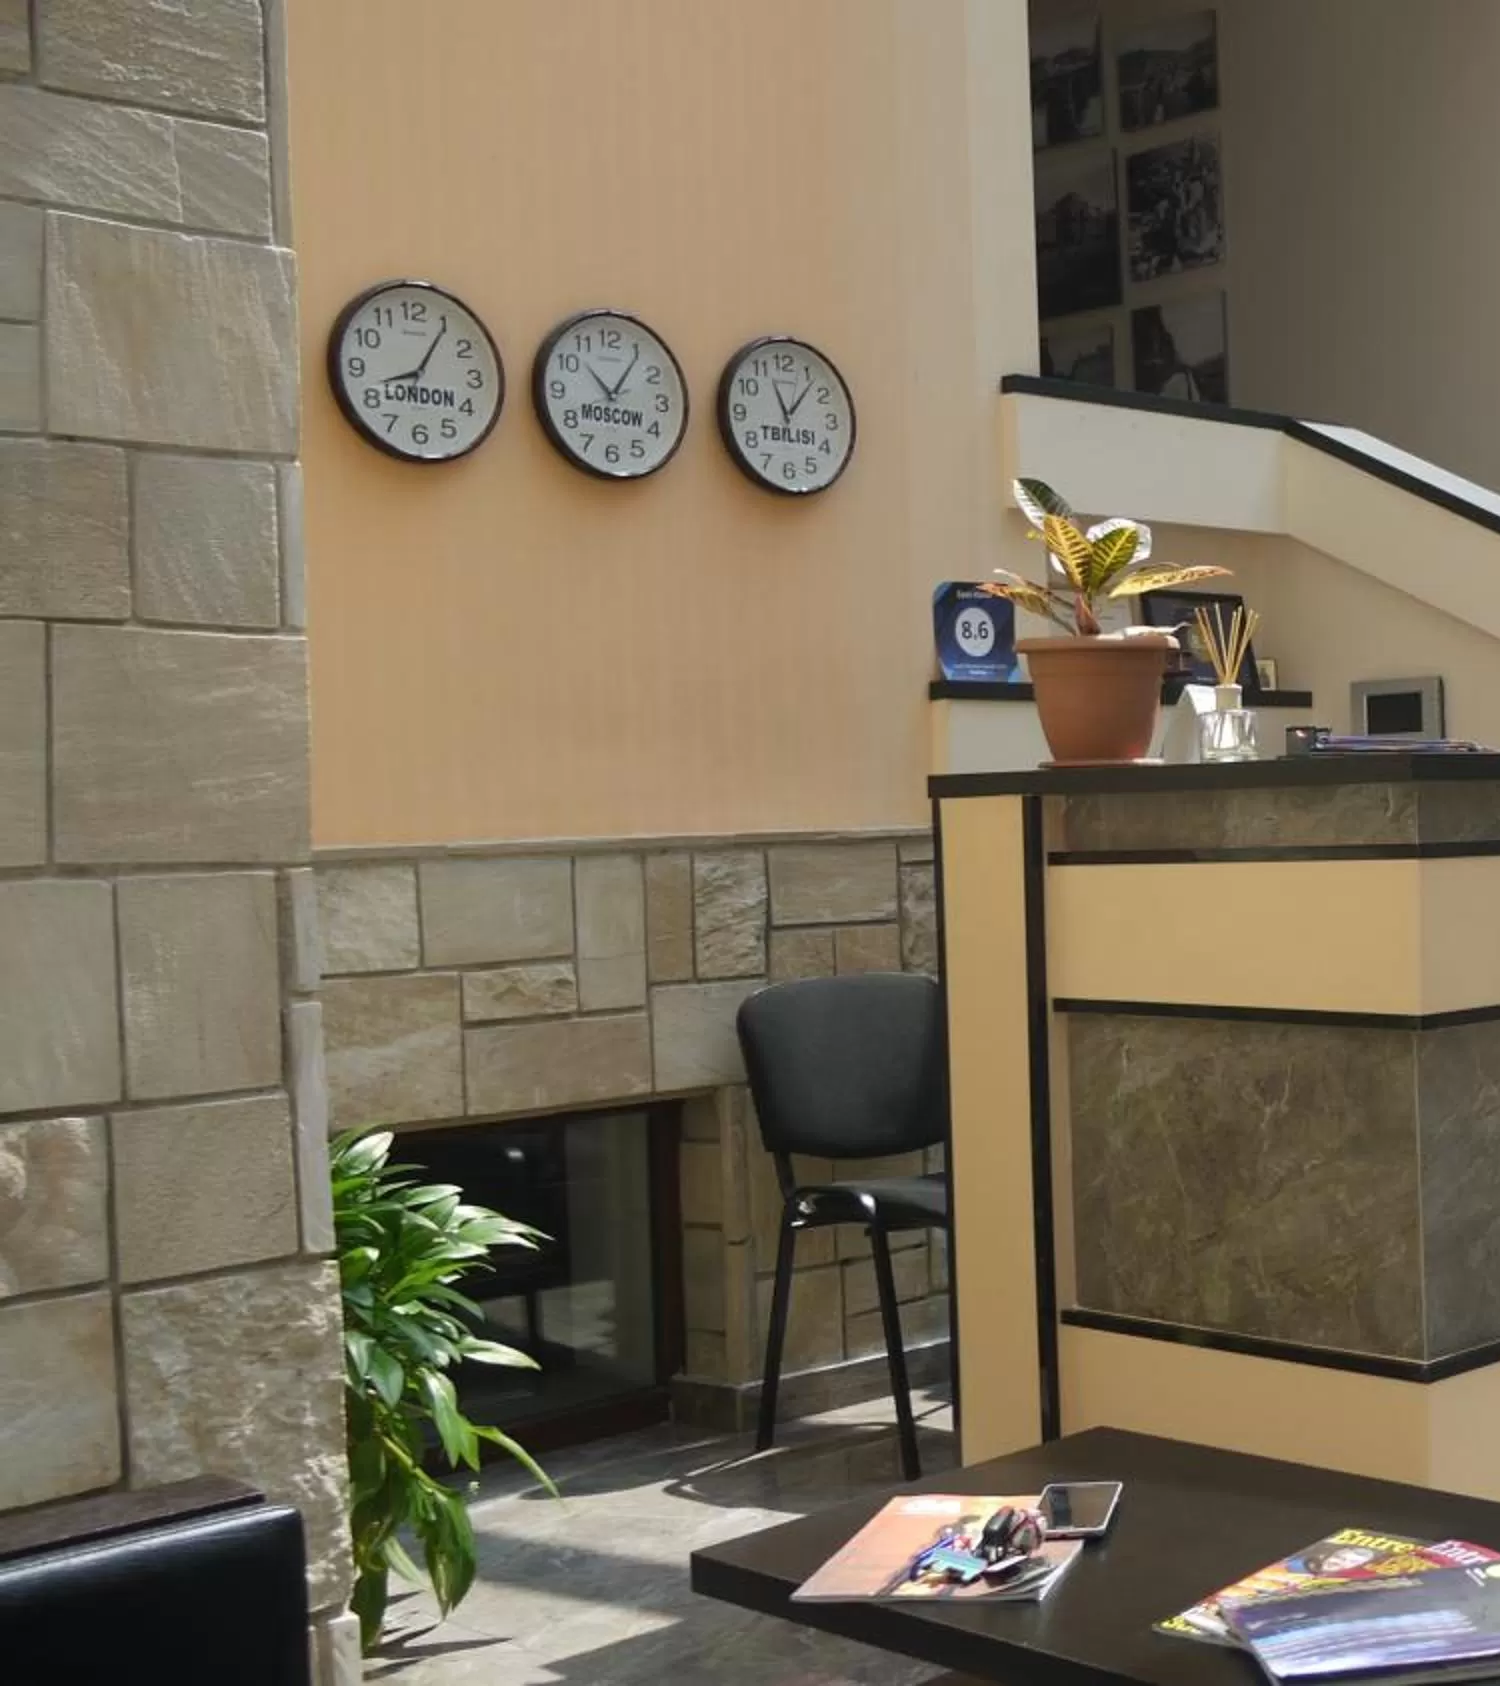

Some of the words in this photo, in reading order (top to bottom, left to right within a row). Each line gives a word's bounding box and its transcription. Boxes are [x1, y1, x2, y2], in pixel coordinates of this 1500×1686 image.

[374, 307, 393, 328] 11
[400, 301, 427, 323] 12
[354, 328, 381, 349] 10
[575, 335, 591, 352] 11
[599, 329, 621, 350] 12
[456, 339, 472, 359] 2
[349, 357, 365, 378] 9
[558, 353, 579, 373] 10
[752, 359, 768, 376] 11
[772, 352, 794, 372] 12
[467, 369, 483, 389] 3
[646, 366, 661, 385] 2
[804, 367, 810, 381] 1
[384, 384, 454, 407] LONDON
[550, 381, 565, 400] 9
[738, 378, 759, 396] 10
[817, 388, 830, 404] 2
[364, 388, 380, 409] 8
[459, 398, 475, 416] 4
[656, 395, 669, 413] 3
[564, 409, 578, 429] 8
[581, 403, 643, 427] MOSCOW
[733, 403, 747, 421] 9
[381, 413, 399, 433] 7
[441, 418, 457, 439] 5
[647, 421, 660, 439] 4
[825, 414, 839, 431] 3
[411, 424, 429, 445] 6
[580, 433, 594, 452] 7
[745, 431, 758, 448] 8
[761, 425, 815, 445] TBILISI
[605, 444, 620, 463] 6
[630, 440, 645, 458] 5
[819, 439, 831, 455] 4
[760, 453, 773, 471] 7
[783, 462, 796, 480] 6
[805, 456, 817, 474] 5
[961, 621, 989, 640] 8.6
